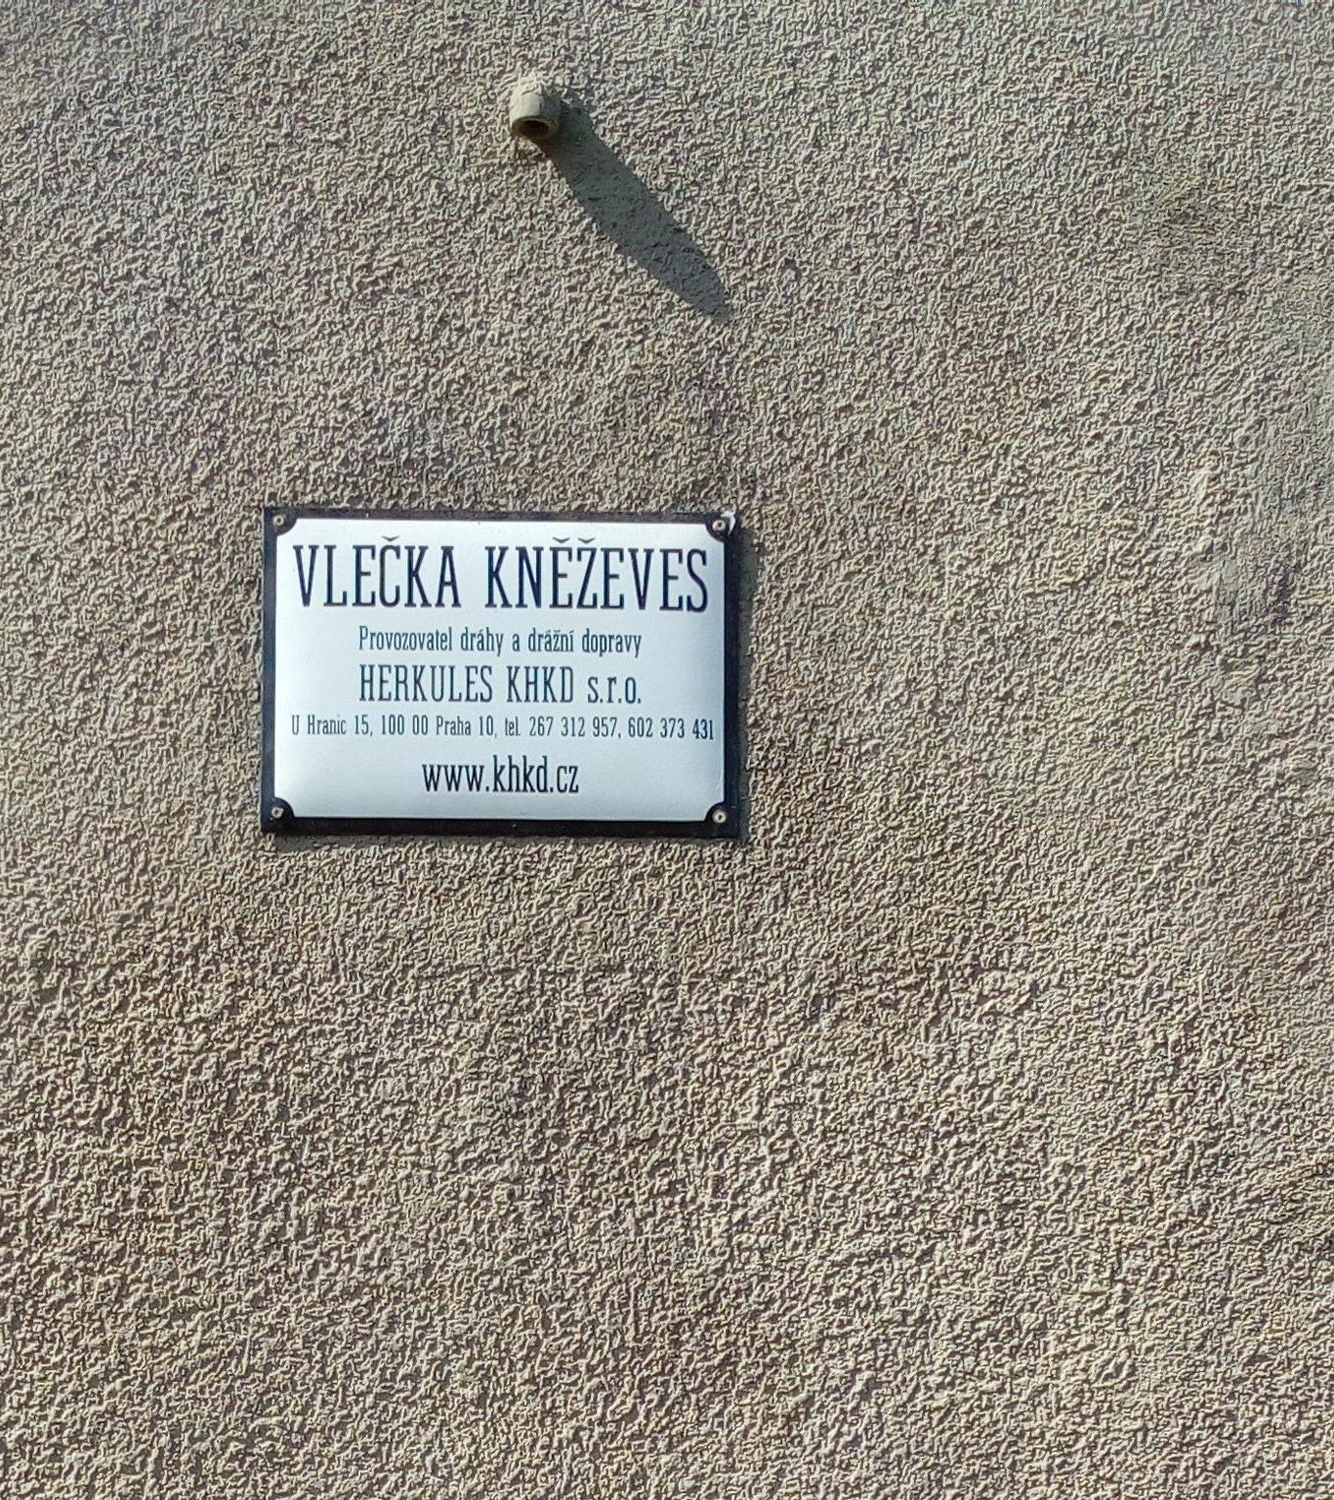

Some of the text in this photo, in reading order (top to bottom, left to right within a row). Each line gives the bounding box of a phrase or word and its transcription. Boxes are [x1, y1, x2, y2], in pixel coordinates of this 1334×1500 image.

[292, 535, 709, 613] VLEČKA KNĚŽEVES
[359, 625, 643, 658] Provozovatel dráhy a drážní dopravy
[359, 664, 642, 704] HERKULES KHKD s.r.o.
[291, 715, 300, 735] U
[307, 714, 347, 735] Hranic
[354, 715, 373, 737] 15,
[381, 715, 405, 736] 100
[412, 715, 429, 736] 00
[436, 715, 472, 737] Praha
[479, 715, 498, 738] 10,
[529, 716, 554, 737] 267
[561, 716, 586, 738] 312
[593, 716, 622, 740] 957,
[628, 717, 654, 739] 602
[660, 718, 685, 739] 373
[692, 718, 714, 741] 431
[422, 754, 580, 793] www.khkd.cz
